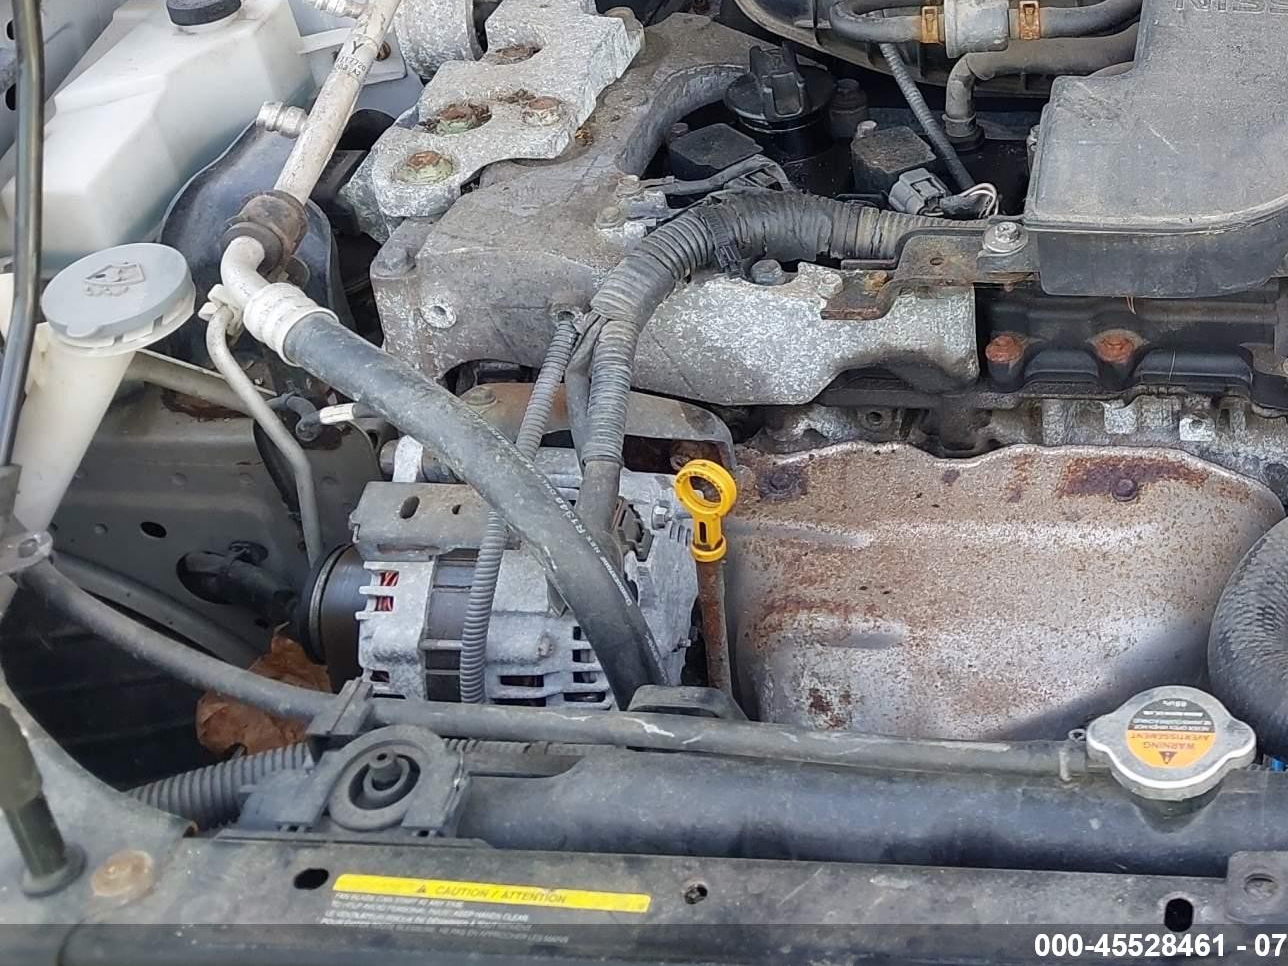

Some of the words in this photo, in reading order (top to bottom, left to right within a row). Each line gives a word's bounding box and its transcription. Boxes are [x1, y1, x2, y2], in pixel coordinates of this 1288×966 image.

[351, 40, 365, 55] Y
[1130, 732, 1210, 742] AVERTISSEMENT
[1143, 741, 1195, 751] WARNING
[435, 885, 490, 898] CAUTION
[500, 890, 567, 904] ATTENTION
